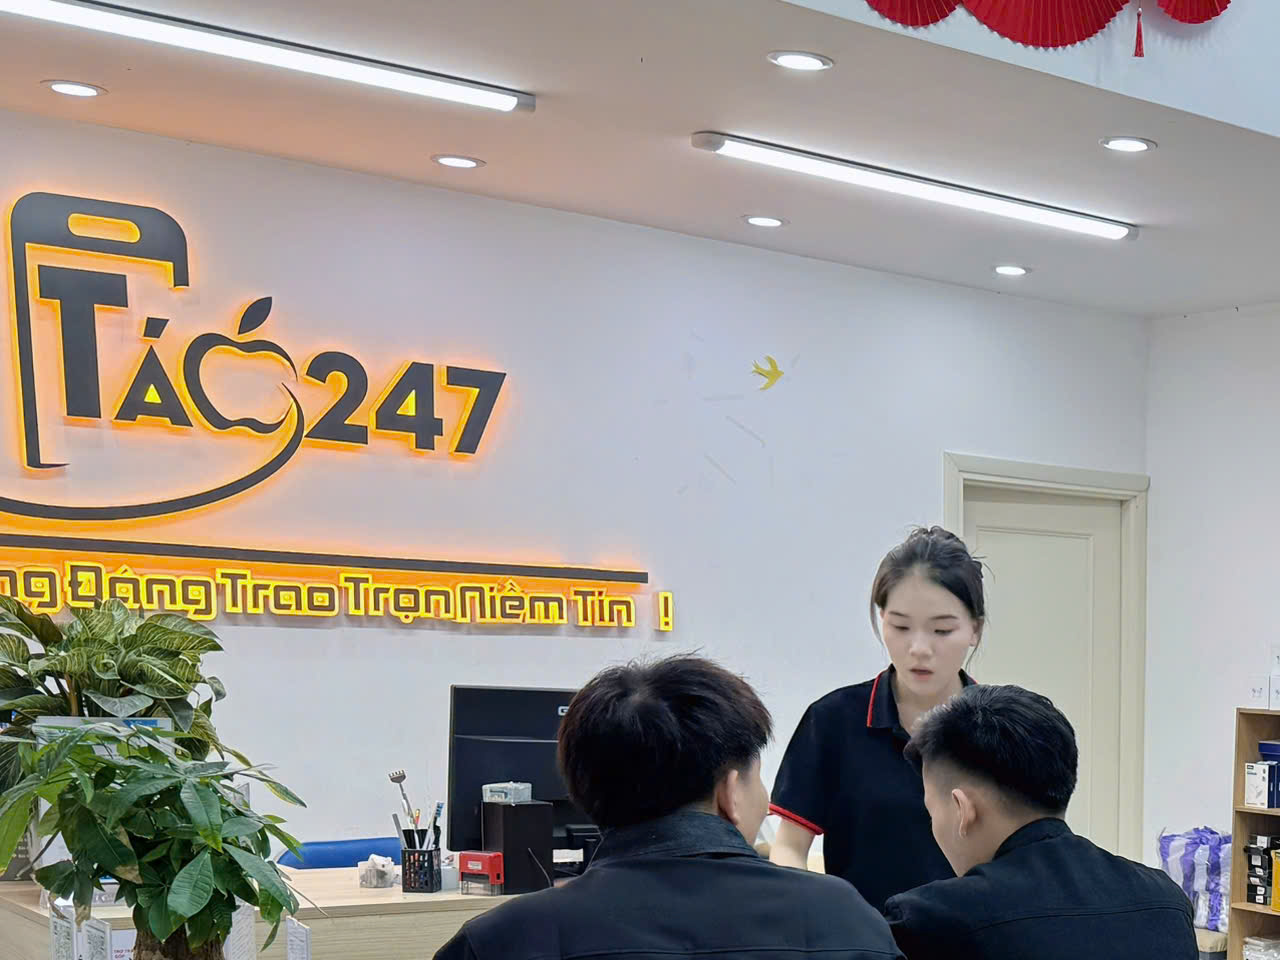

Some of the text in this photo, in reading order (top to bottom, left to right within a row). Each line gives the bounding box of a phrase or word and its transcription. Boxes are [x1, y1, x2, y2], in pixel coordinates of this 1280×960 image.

[65, 561, 217, 622] Đáng
[217, 568, 339, 616] Trao
[339, 573, 455, 624] Trọn
